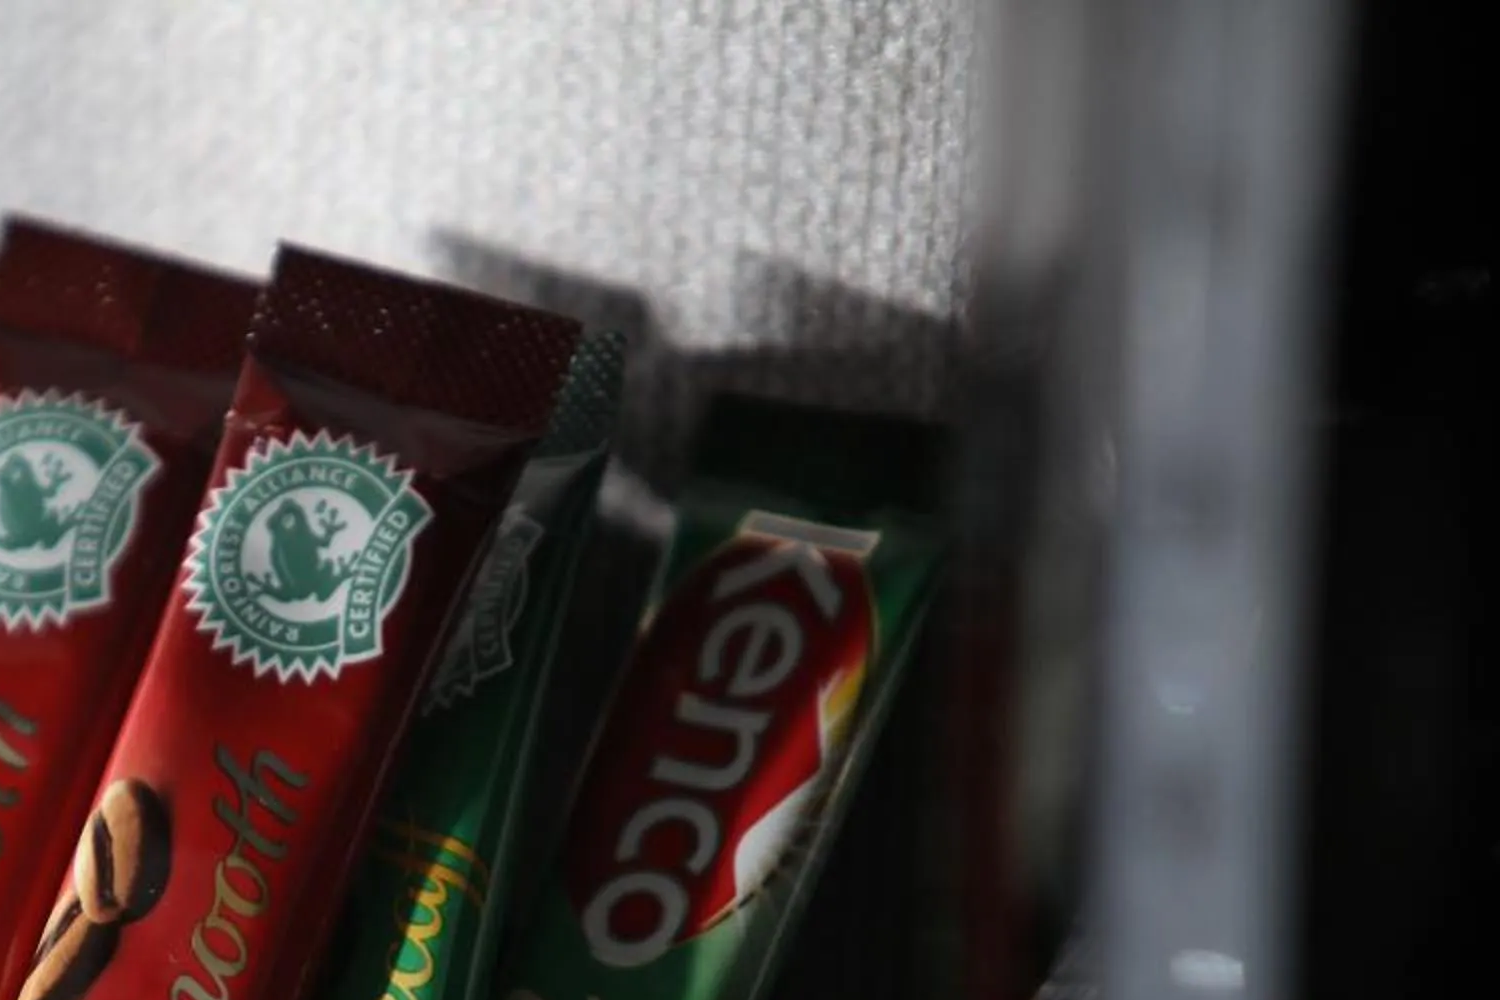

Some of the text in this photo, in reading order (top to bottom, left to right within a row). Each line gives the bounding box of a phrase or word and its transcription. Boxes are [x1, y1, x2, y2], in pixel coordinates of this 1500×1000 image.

[73, 458, 135, 586] CERTIFIED
[218, 464, 357, 642] RAINFOREST ALLIANCE
[348, 509, 409, 639] CERTIFIED
[582, 509, 882, 968] Kenco
